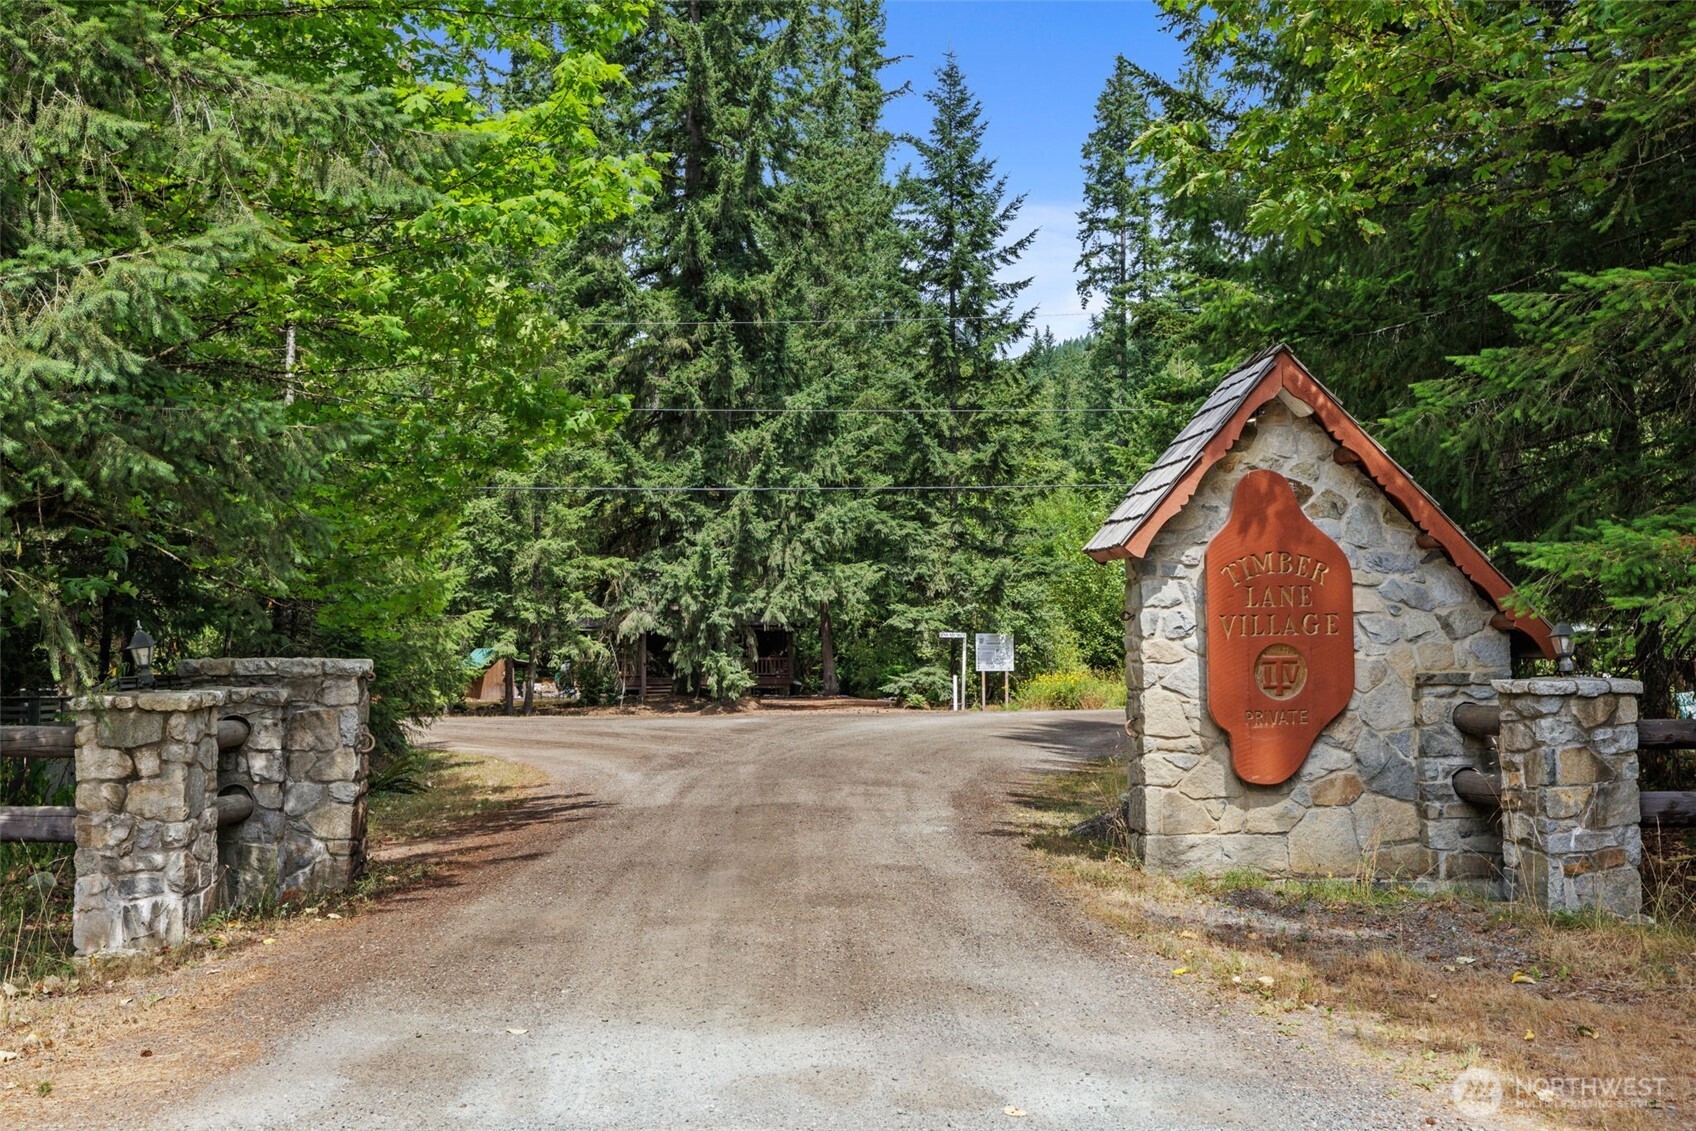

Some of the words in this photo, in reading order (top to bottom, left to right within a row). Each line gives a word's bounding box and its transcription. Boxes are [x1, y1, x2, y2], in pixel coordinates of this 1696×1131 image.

[1220, 551, 1330, 588] TIMBER
[1245, 585, 1313, 608] LANE
[1219, 612, 1340, 640] VILLAGE
[1246, 709, 1308, 727] PRIVATE
